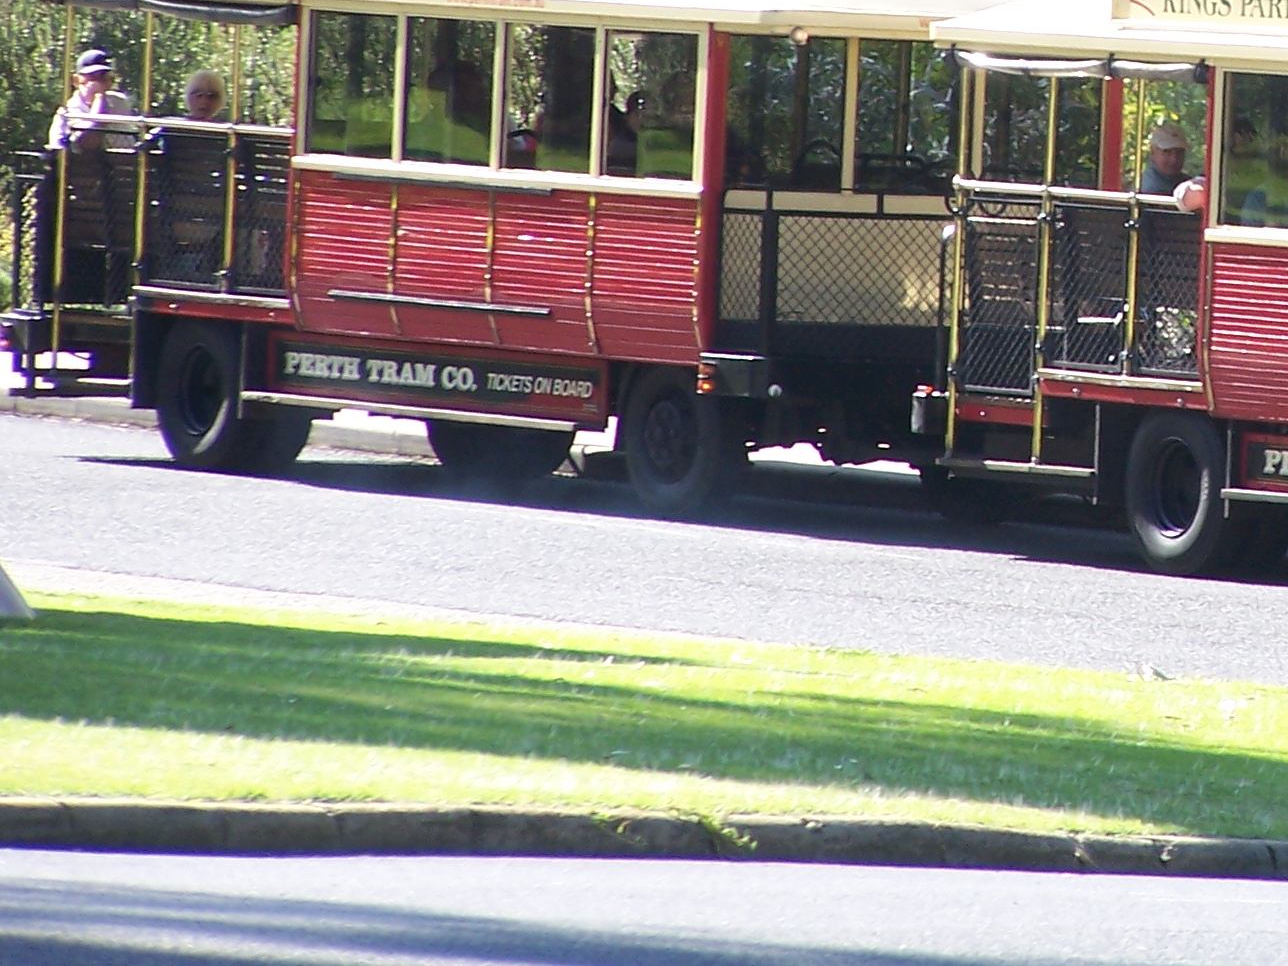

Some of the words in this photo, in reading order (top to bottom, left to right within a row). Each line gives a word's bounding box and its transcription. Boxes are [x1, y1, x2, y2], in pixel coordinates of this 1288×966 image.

[284, 351, 360, 380] PERTH
[365, 359, 435, 387] TRAM
[440, 365, 477, 392] CO.
[486, 373, 532, 395] TICKETS
[534, 378, 551, 395] ON
[552, 379, 592, 399] BOARD
